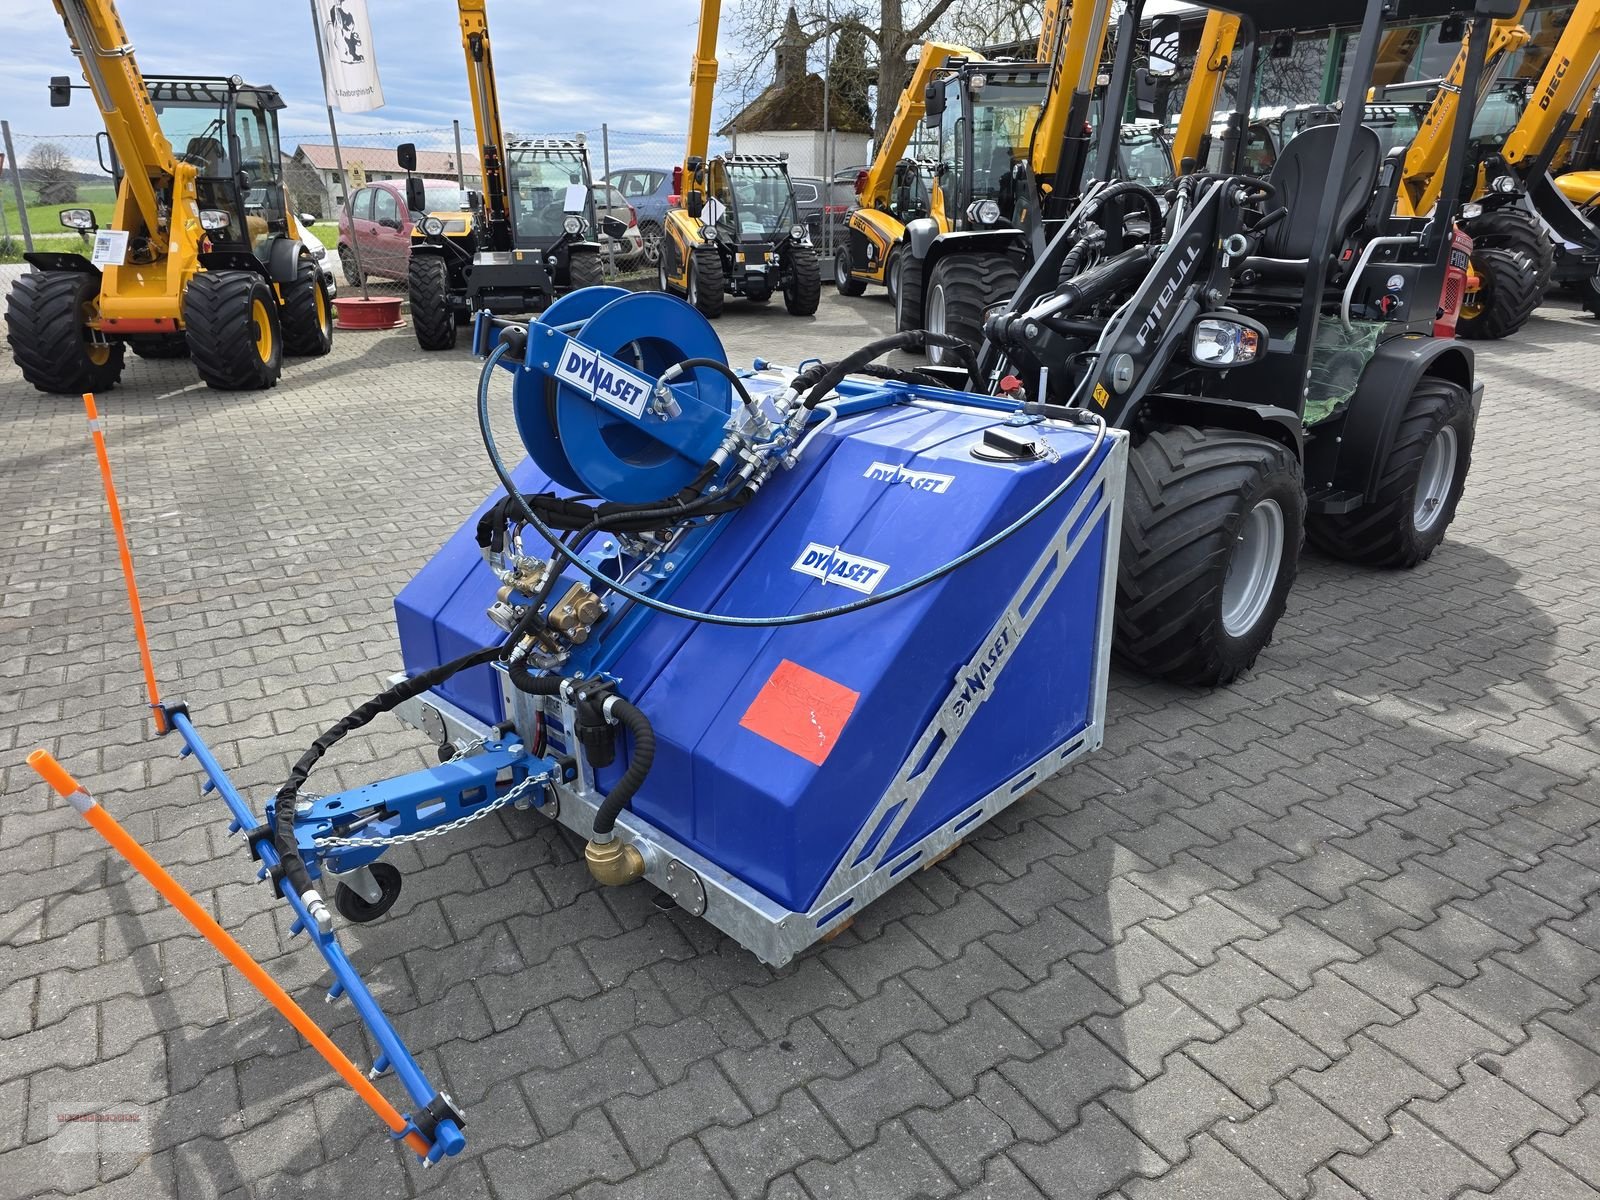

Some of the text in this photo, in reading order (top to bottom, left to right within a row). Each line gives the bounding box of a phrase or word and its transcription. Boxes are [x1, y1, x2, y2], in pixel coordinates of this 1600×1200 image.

[1539, 56, 1570, 111] DIECI
[1136, 245, 1200, 347] PITBULL
[565, 351, 643, 406] DYNASET
[802, 548, 879, 584] DYNASET
[953, 626, 1009, 718] DYNASET
